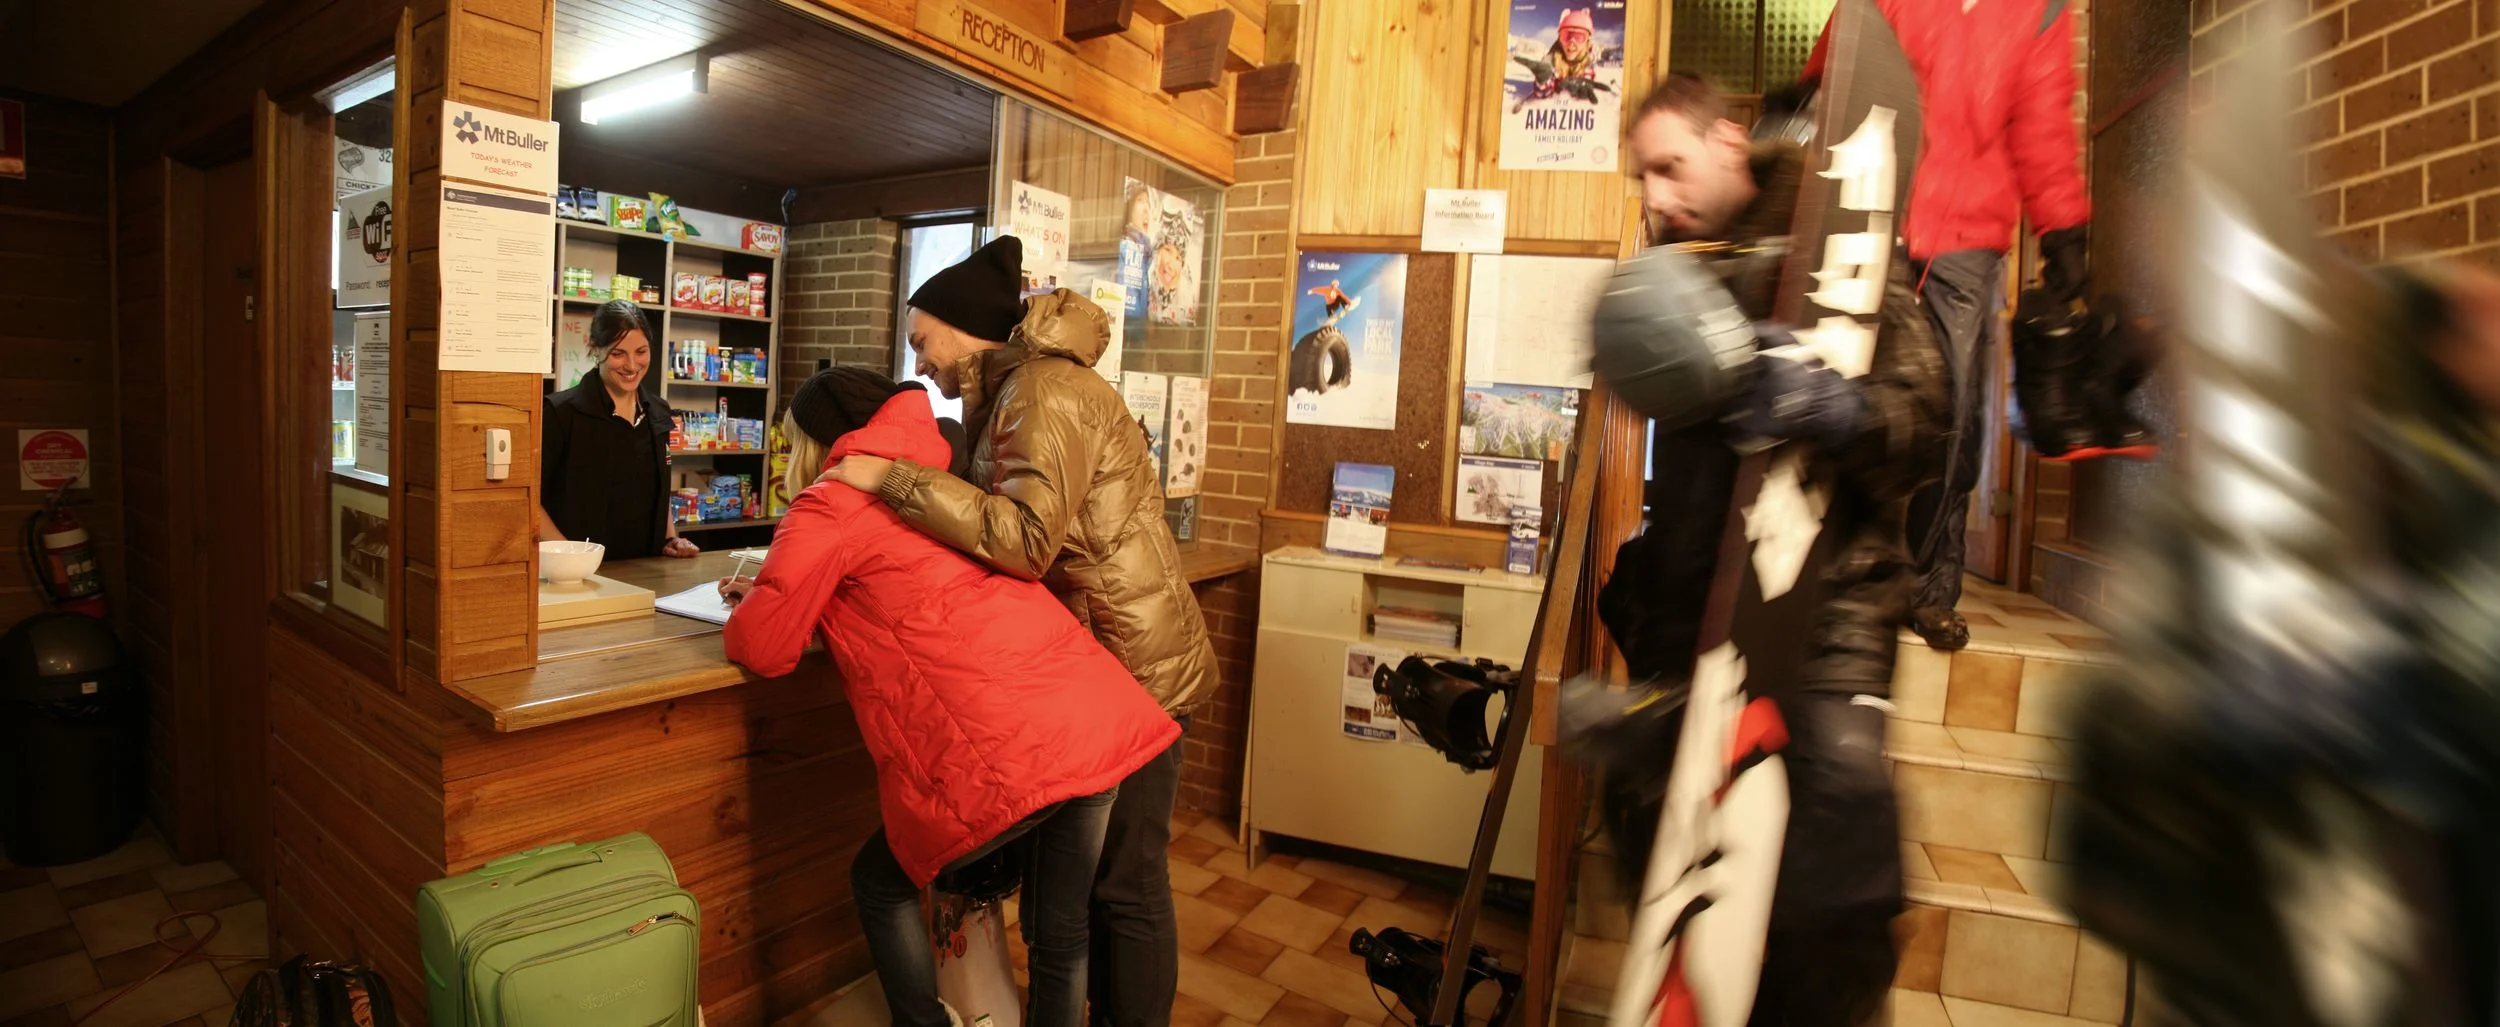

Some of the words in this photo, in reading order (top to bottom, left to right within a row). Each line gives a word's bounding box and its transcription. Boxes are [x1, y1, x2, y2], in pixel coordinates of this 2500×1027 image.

[962, 9, 1045, 73] RECEPTION
[1525, 109, 1595, 130] AMAZING
[471, 152, 499, 163] TODAY'S
[501, 157, 532, 168] WEATHER
[484, 166, 518, 177] FORECAST
[754, 231, 779, 244] SAVOY
